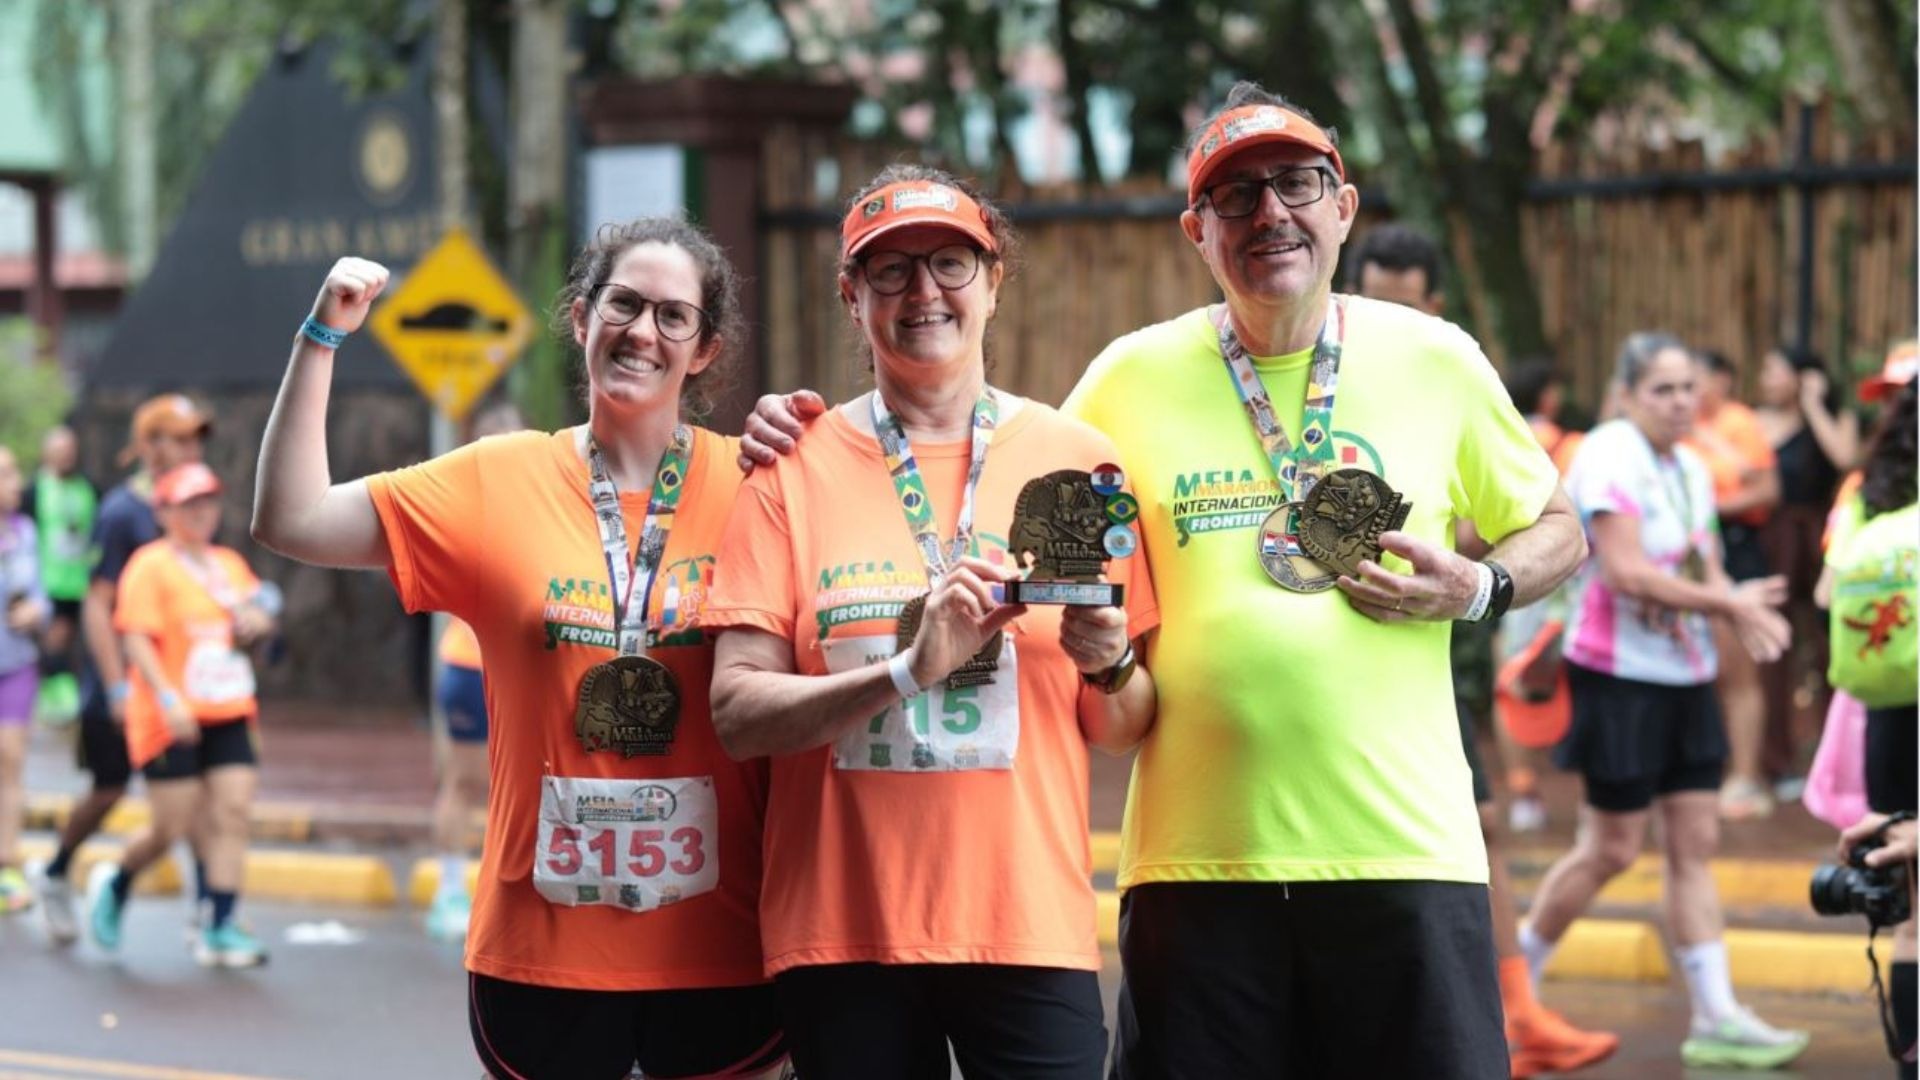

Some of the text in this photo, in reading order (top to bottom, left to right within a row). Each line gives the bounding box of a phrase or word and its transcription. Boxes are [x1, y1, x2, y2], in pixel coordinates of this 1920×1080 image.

[1174, 469, 1254, 499] MEIA
[1173, 493, 1289, 516] INTERNACIONA
[818, 560, 896, 592] MEIA
[816, 585, 930, 607] INTERNACIONA
[577, 795, 615, 806] MEIA
[546, 826, 705, 877] 5153
